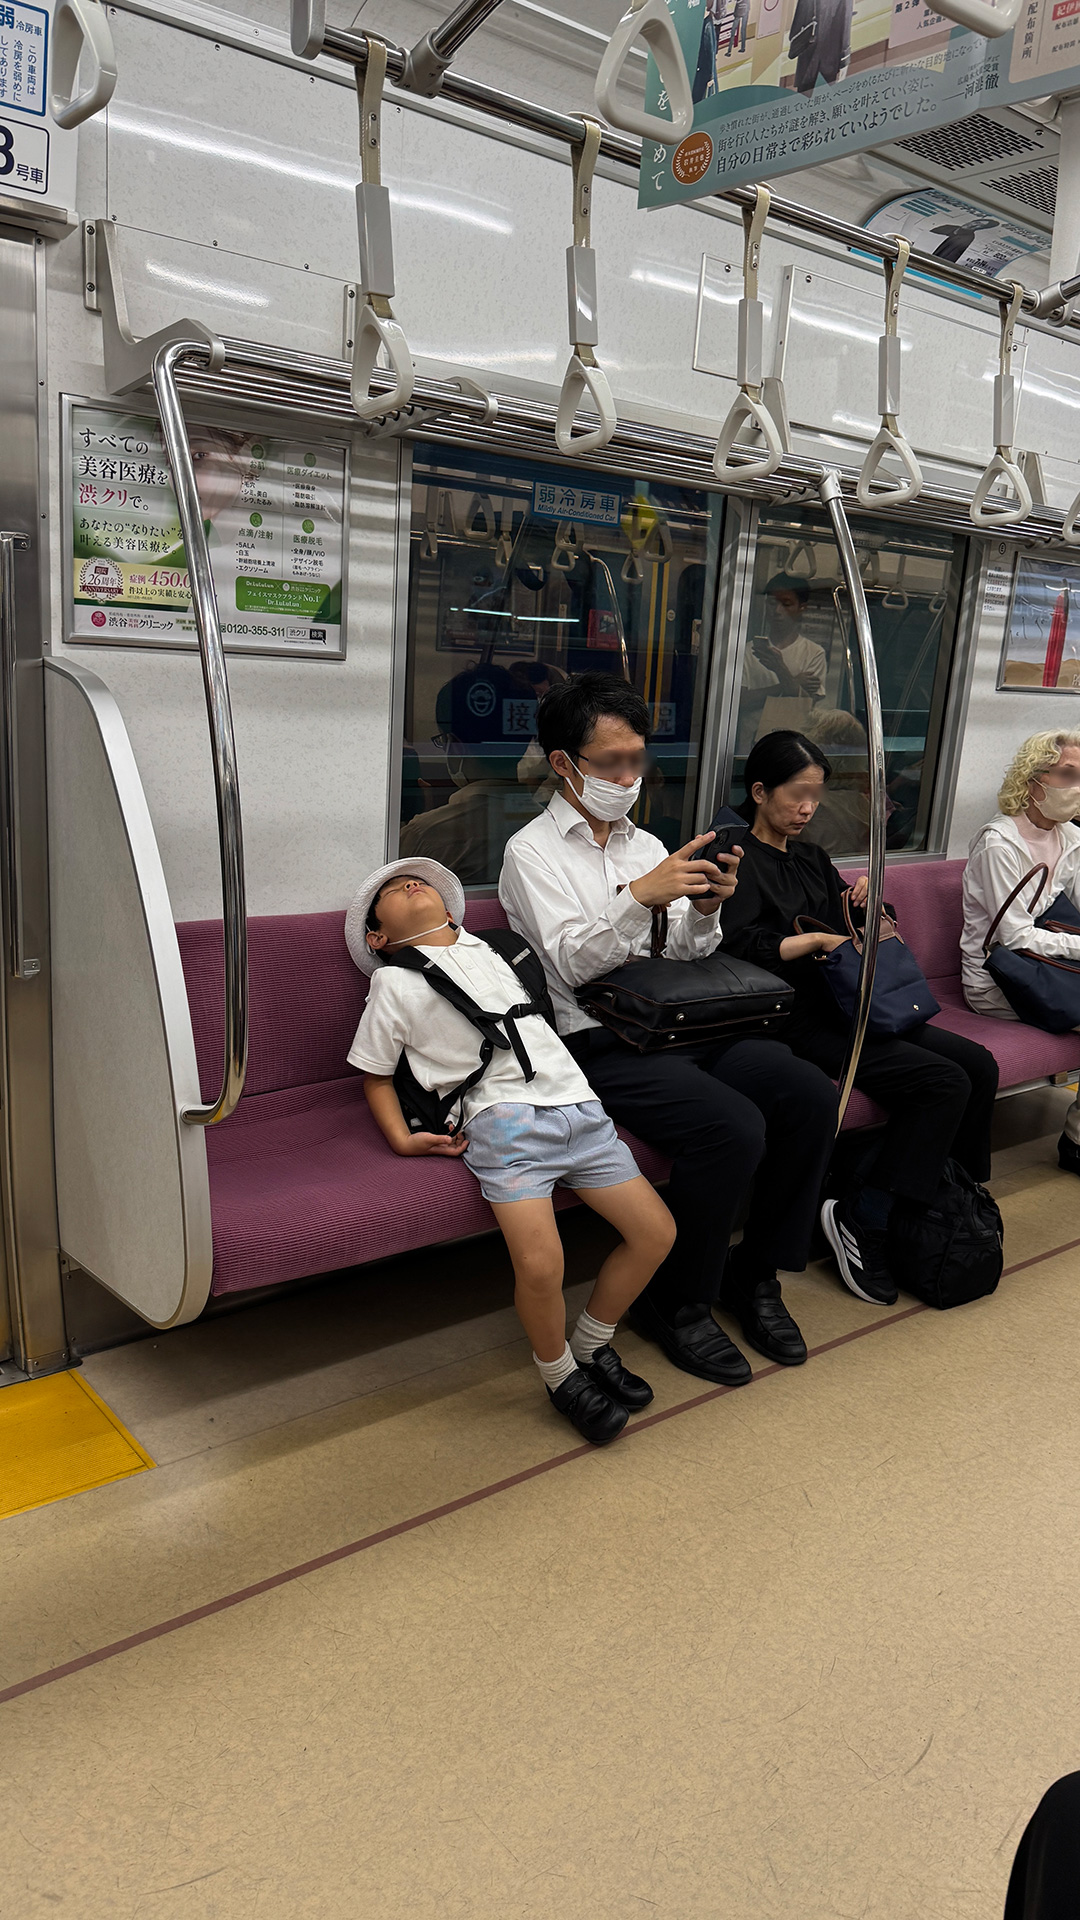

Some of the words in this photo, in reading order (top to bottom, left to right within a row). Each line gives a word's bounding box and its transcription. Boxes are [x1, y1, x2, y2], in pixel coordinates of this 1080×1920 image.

[1021, 2, 1039, 59] 配布箇所
[13, 40, 23, 103] 冷房を弱めに
[27, 45, 37, 96] この車両は
[716, 97, 937, 175] 自分の日常まで彩られていくようでした。
[79, 427, 149, 455] すべての
[78, 454, 169, 485] 美容医療を
[287, 466, 333, 480] 医療ダイエット
[78, 483, 149, 511] 渋クリで。
[538, 485, 616, 513] 弱冷房車
[537, 504, 556, 515] Mildly
[557, 507, 604, 521] Air-Conditioned
[604, 513, 616, 522] Car
[80, 534, 176, 555] 叶える美容医療を。
[238, 528, 274, 540] 点滴/注射
[148, 570, 191, 589] 450,0
[227, 623, 285, 637] 0120-355-311
